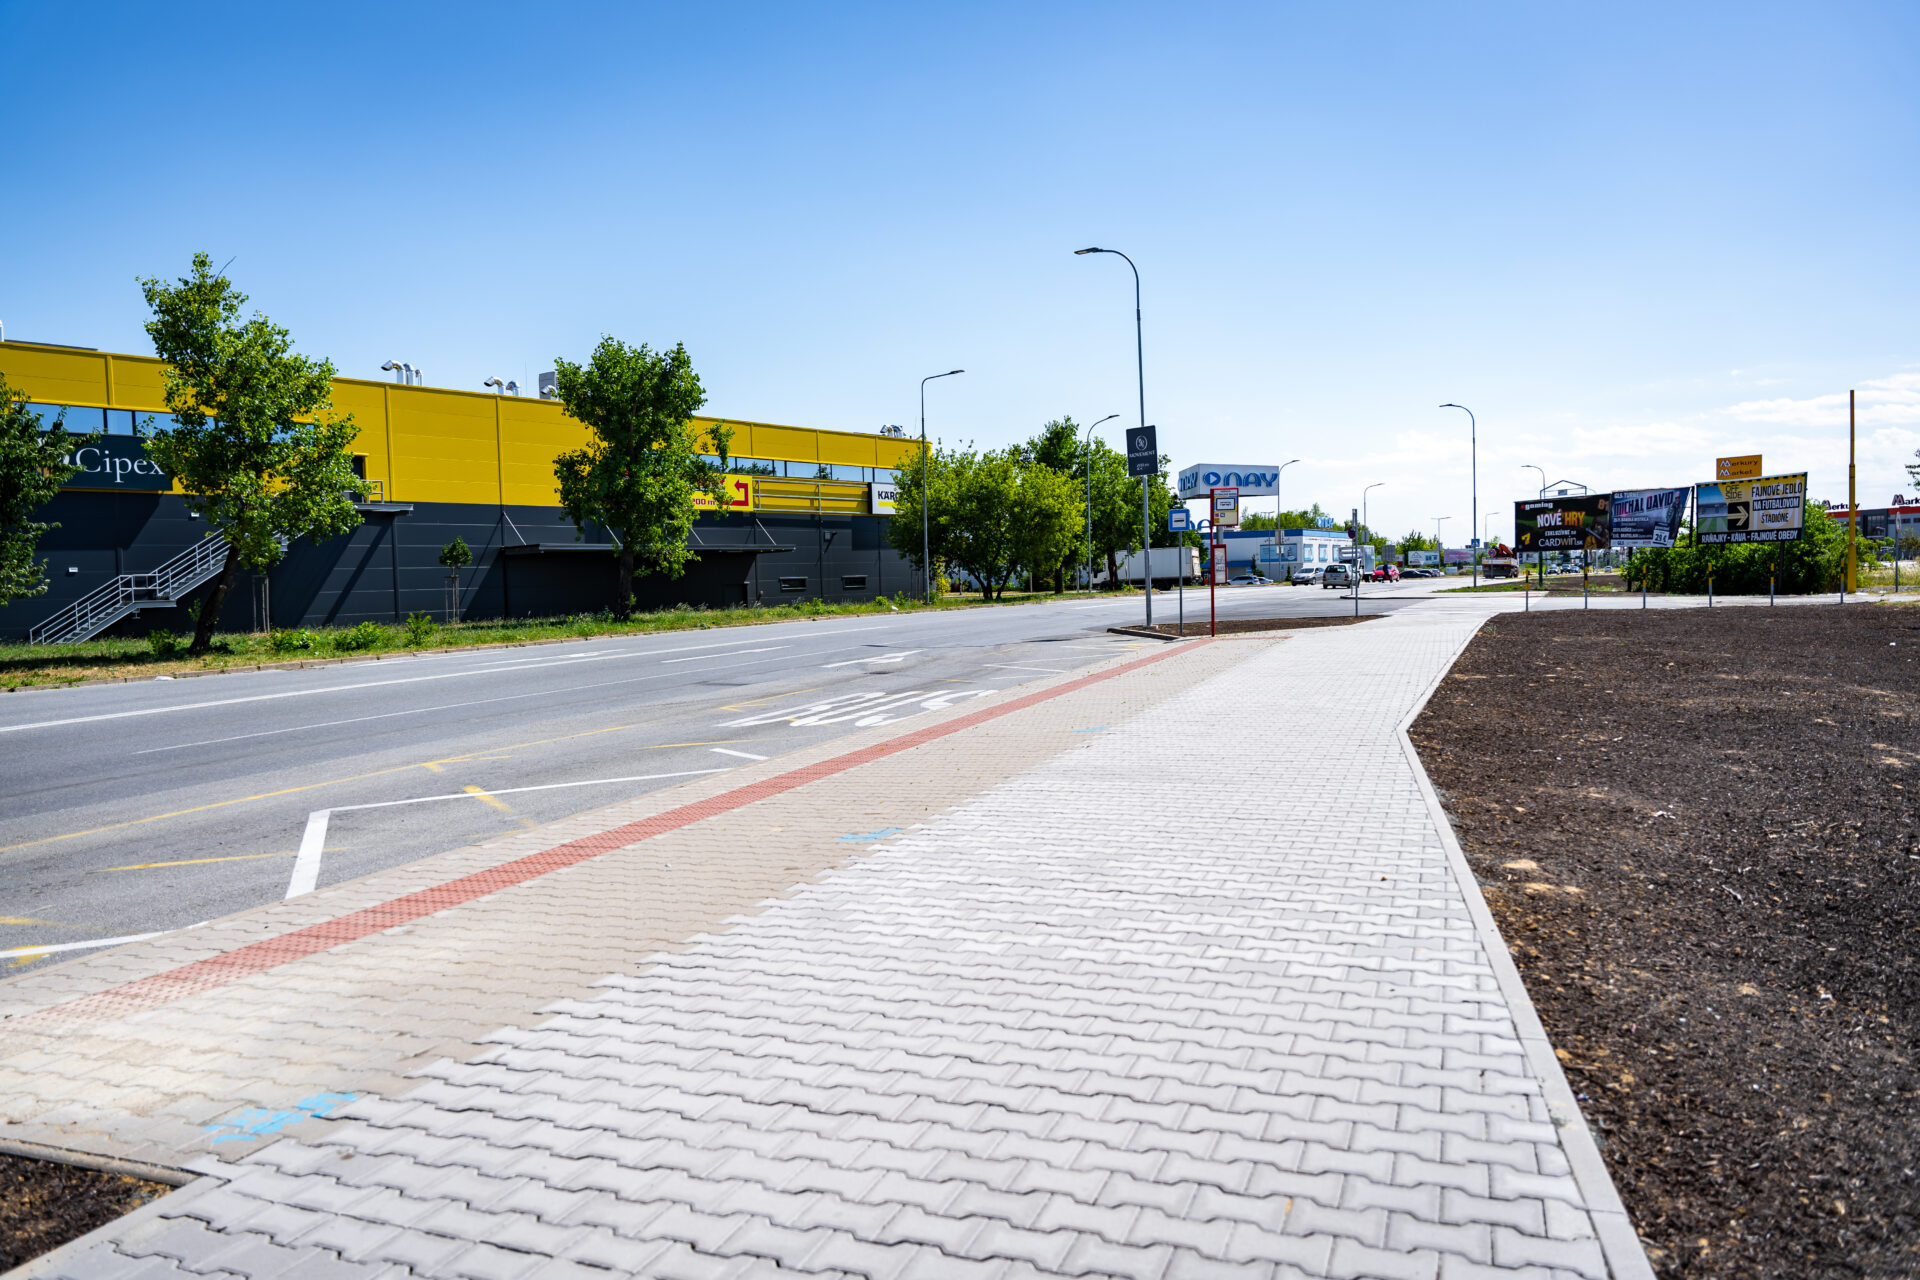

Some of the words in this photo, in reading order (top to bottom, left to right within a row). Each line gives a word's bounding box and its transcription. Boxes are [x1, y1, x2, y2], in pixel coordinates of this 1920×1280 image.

[75, 447, 165, 483] Cipex
[1751, 484, 1780, 498] FAJNOVÉ
[1782, 482, 1803, 495] JEDLO
[1821, 499, 1861, 511] Merkuy
[1536, 508, 1562, 528] NOVÉ
[1564, 511, 1586, 526] HRY
[1778, 529, 1798, 540] OBEDY
